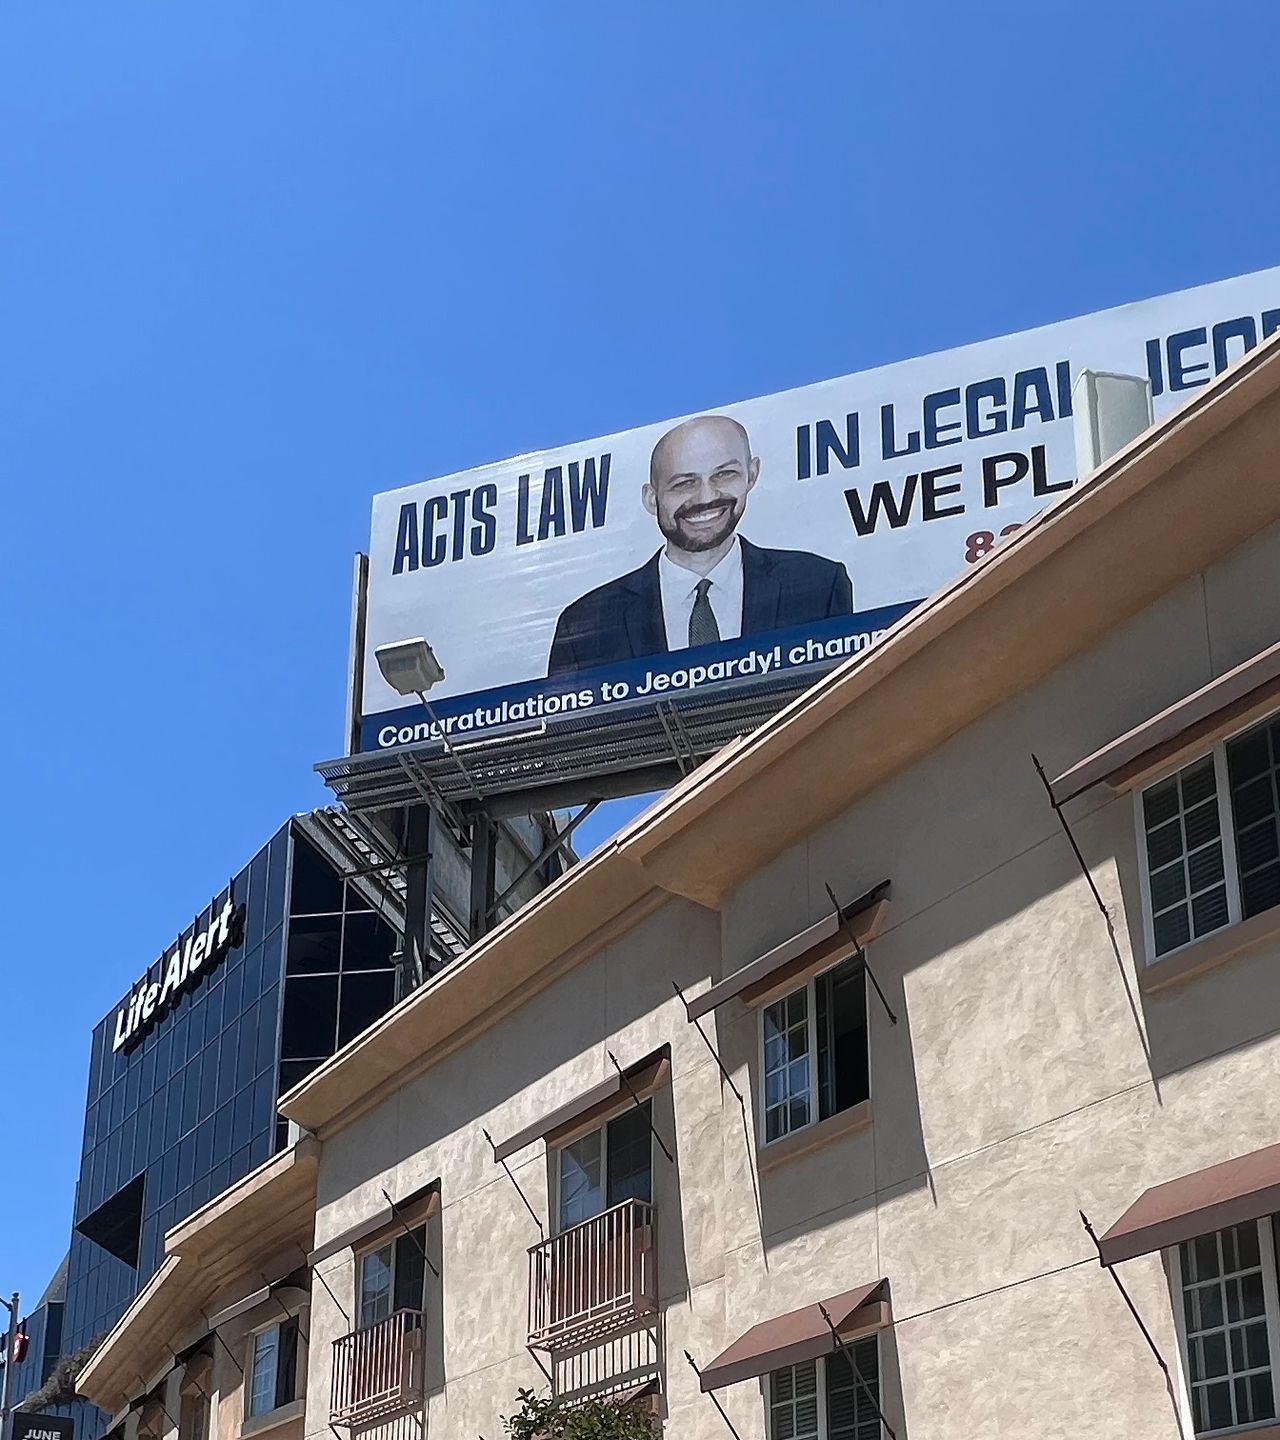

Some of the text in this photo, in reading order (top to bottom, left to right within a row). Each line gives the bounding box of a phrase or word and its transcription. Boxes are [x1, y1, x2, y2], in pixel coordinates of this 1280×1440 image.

[797, 412, 860, 480] IN
[843, 445, 1079, 537] WE PL
[392, 453, 612, 575] ACTS LAW
[377, 682, 595, 749] Congratulations
[600, 679, 630, 701] to
[636, 646, 781, 695] Jeopardy!
[113, 898, 234, 1053] Life Alert
[24, 1429, 61, 1440] JUNE
